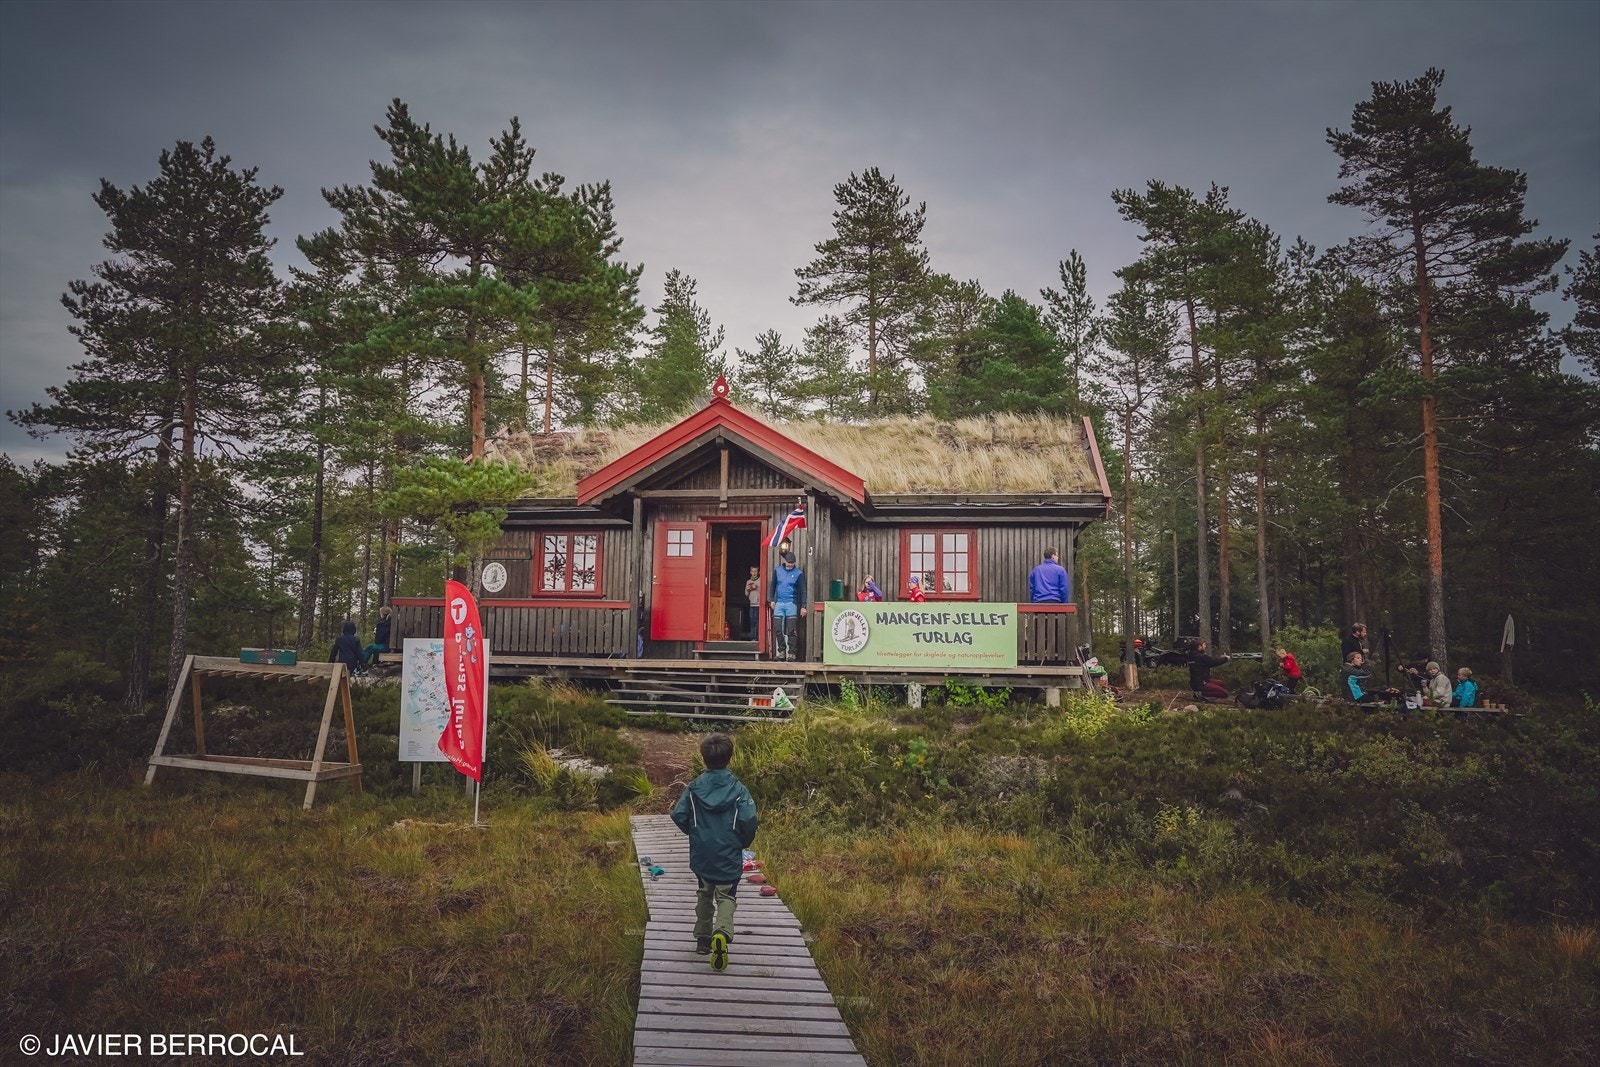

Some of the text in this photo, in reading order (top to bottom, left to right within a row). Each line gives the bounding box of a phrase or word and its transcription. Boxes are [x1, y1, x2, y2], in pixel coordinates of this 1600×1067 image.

[833, 611, 867, 637] MANGENFJELLET
[876, 612, 1009, 627] MANGENFJELLET
[841, 640, 863, 652] TURLAG
[912, 631, 973, 646] TURLAG
[913, 650, 922, 658] for
[948, 652, 956, 660] og
